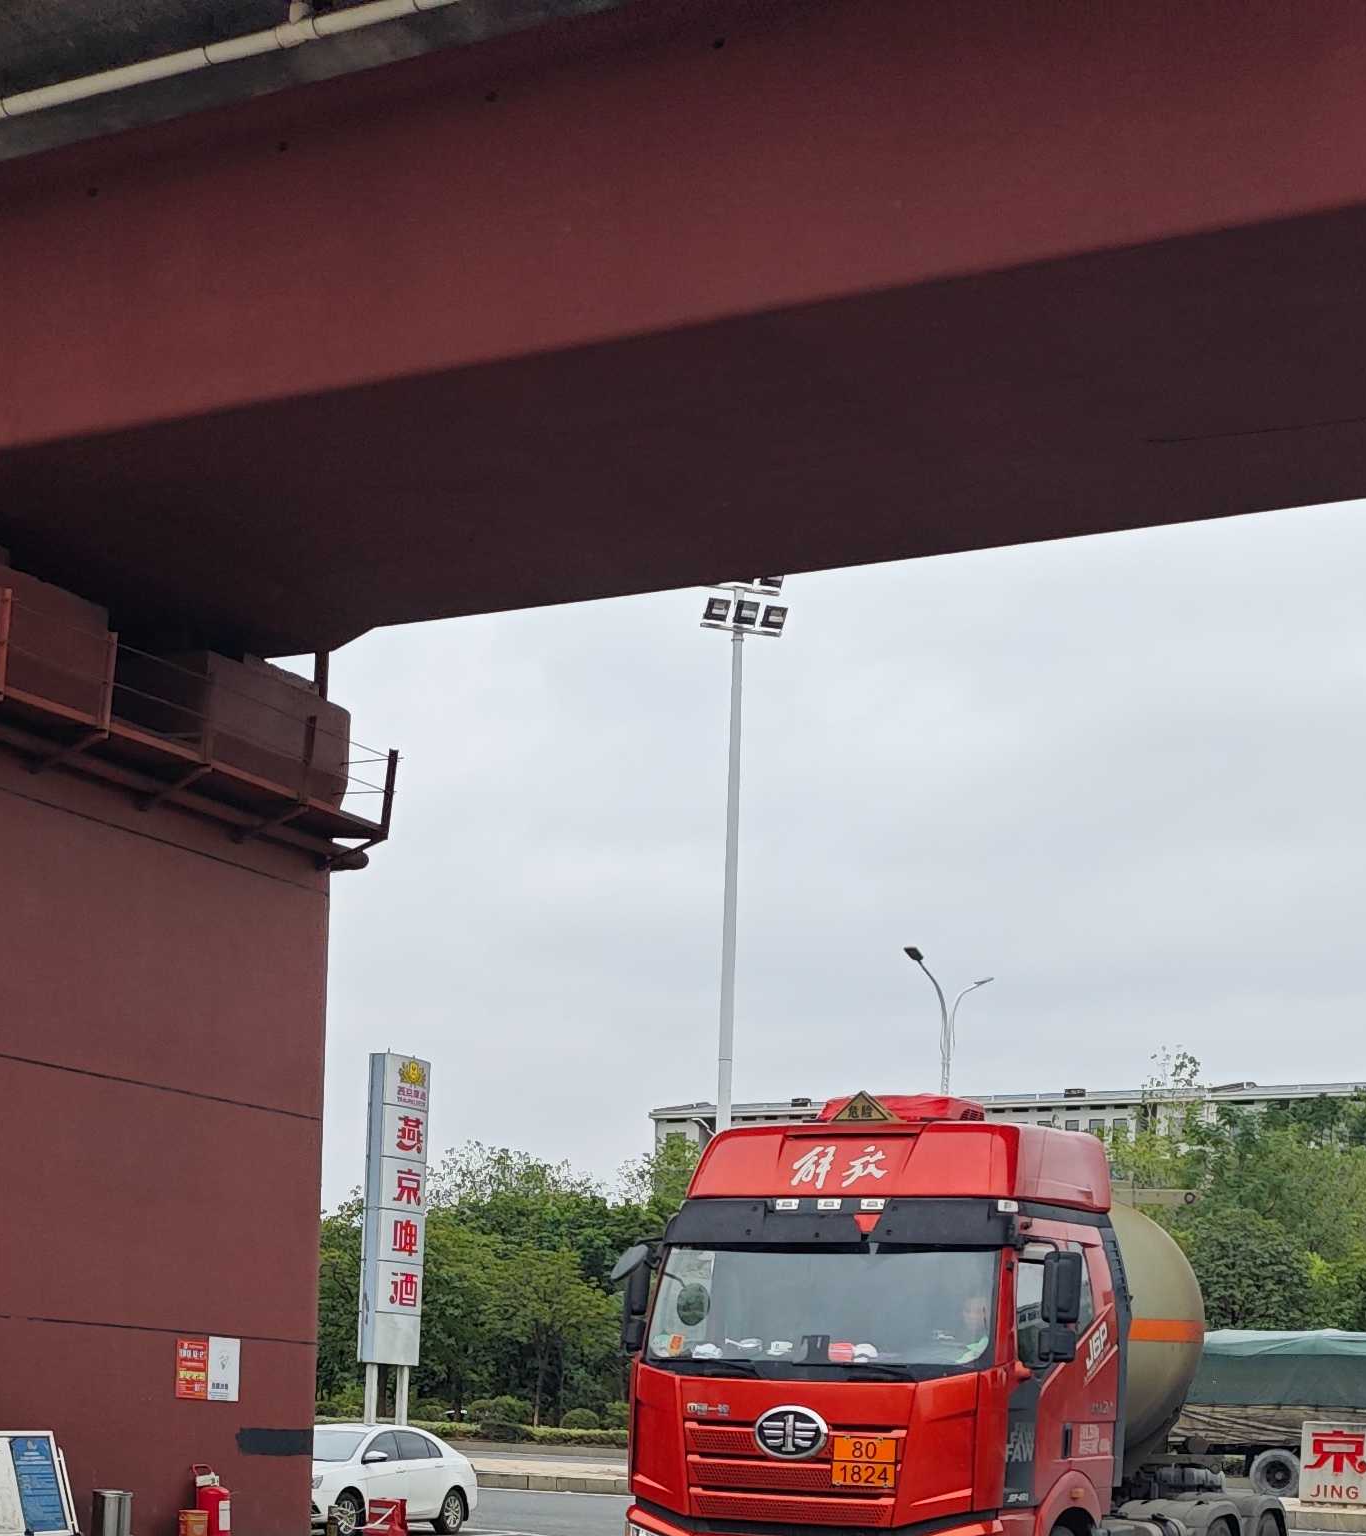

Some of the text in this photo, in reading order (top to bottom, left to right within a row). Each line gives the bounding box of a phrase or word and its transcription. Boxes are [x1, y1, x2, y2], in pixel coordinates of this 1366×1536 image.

[389, 1115, 423, 1307] 燕京啤酒
[852, 1441, 877, 1459] 80
[841, 1465, 889, 1484] 1824
[1310, 1484, 1359, 1499] JING
